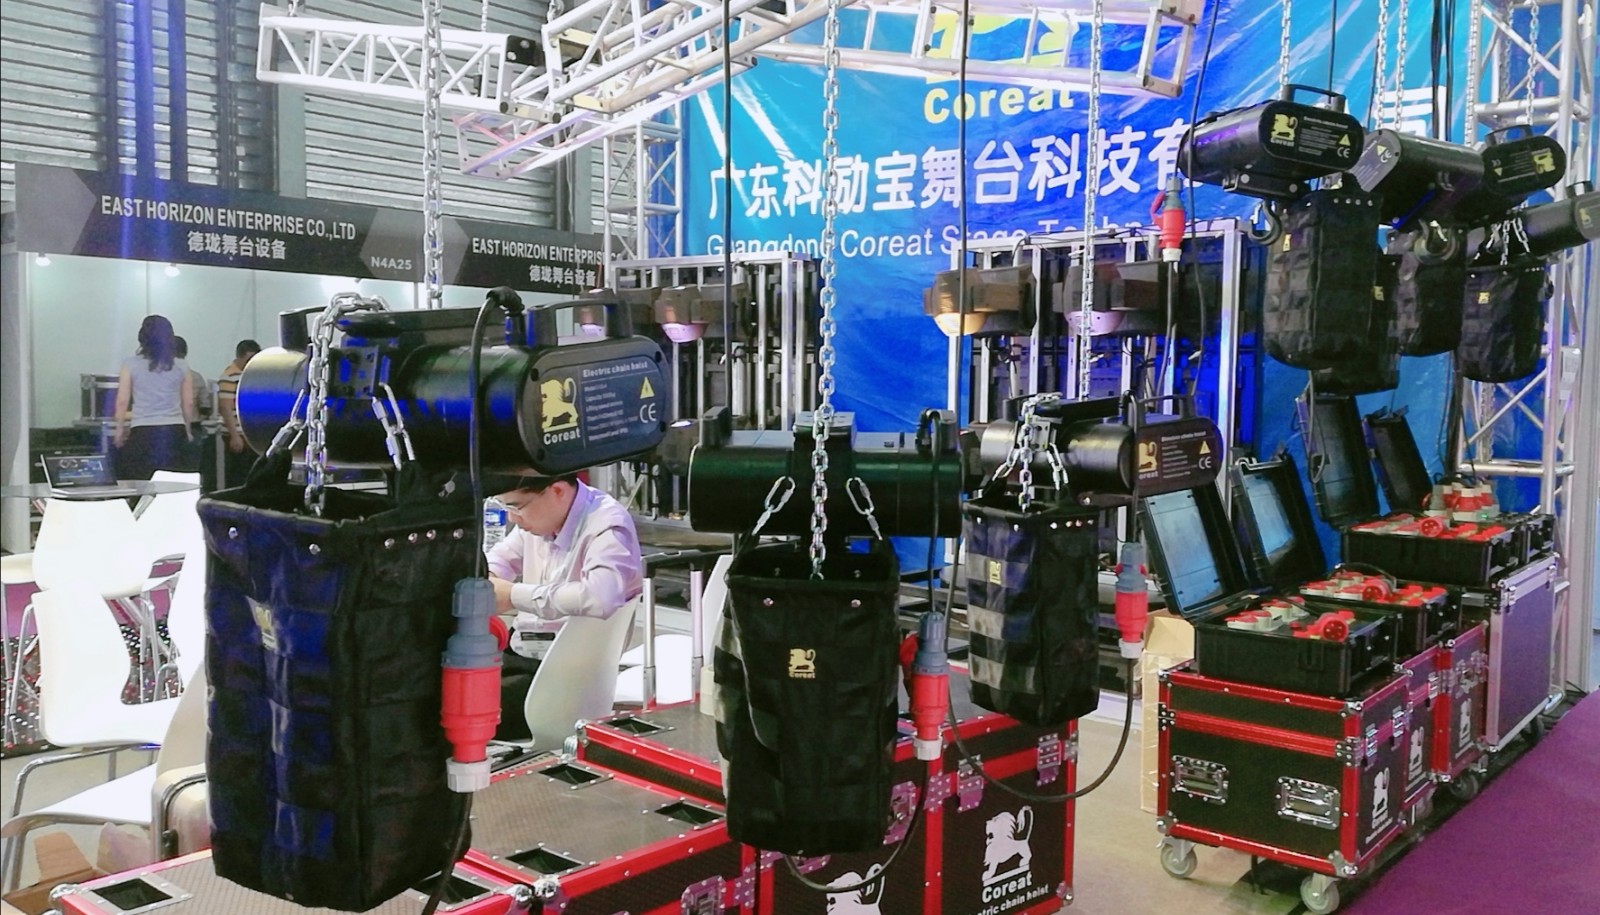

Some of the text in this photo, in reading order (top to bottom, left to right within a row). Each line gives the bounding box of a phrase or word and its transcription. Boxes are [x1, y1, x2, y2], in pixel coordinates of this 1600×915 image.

[924, 86, 1074, 124] Coreat
[101, 195, 356, 241] EAST HORIZON ENTERPRISE CO.,LTD
[187, 231, 287, 260] 德珑舞台设备
[472, 237, 502, 255] EAST
[501, 242, 548, 261] HORIZON
[841, 227, 932, 258] Coreat
[370, 255, 412, 270] N4A25
[583, 361, 648, 378] Electric chain hoist
[640, 402, 656, 423] CE
[543, 427, 581, 445] Coreat
[982, 871, 1032, 903] Coreat
[1000, 894, 1025, 911] chain
[1026, 884, 1048, 901] hoist
